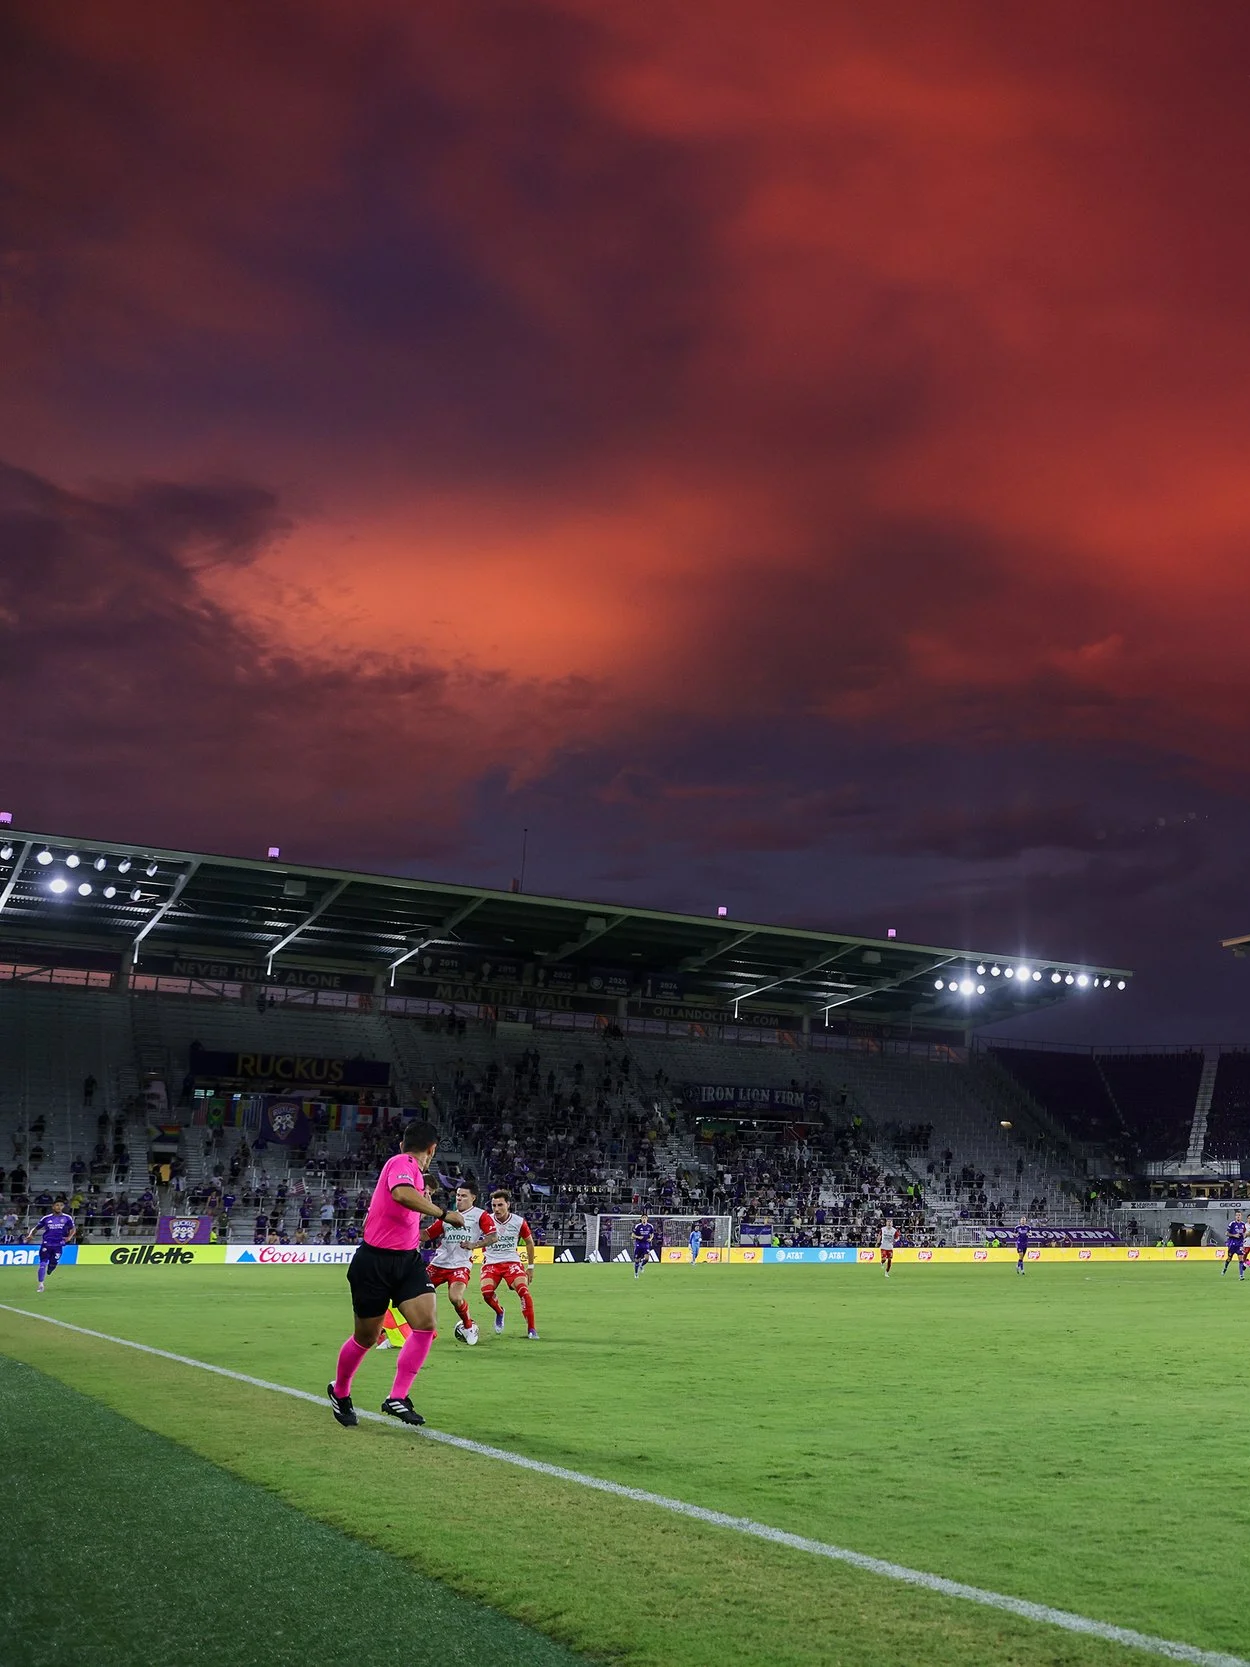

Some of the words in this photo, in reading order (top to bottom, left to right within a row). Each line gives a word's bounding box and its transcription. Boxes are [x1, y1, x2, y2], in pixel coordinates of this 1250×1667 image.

[172, 961, 229, 978] NEVER
[285, 971, 341, 988] ALONE
[433, 983, 482, 1001] MAN
[653, 1007, 779, 1026] ORLANDOCITYC.COM
[236, 1053, 345, 1081] RUCKUS
[700, 1086, 736, 1101] IRON
[738, 1087, 771, 1102] LION
[1069, 1230, 1115, 1239] FIRM
[110, 1245, 195, 1265] Gillette
[259, 1247, 307, 1263] Coors
[309, 1252, 352, 1263] LIGHT
[786, 1251, 804, 1260] AT&T
[828, 1251, 845, 1260] AT&T
